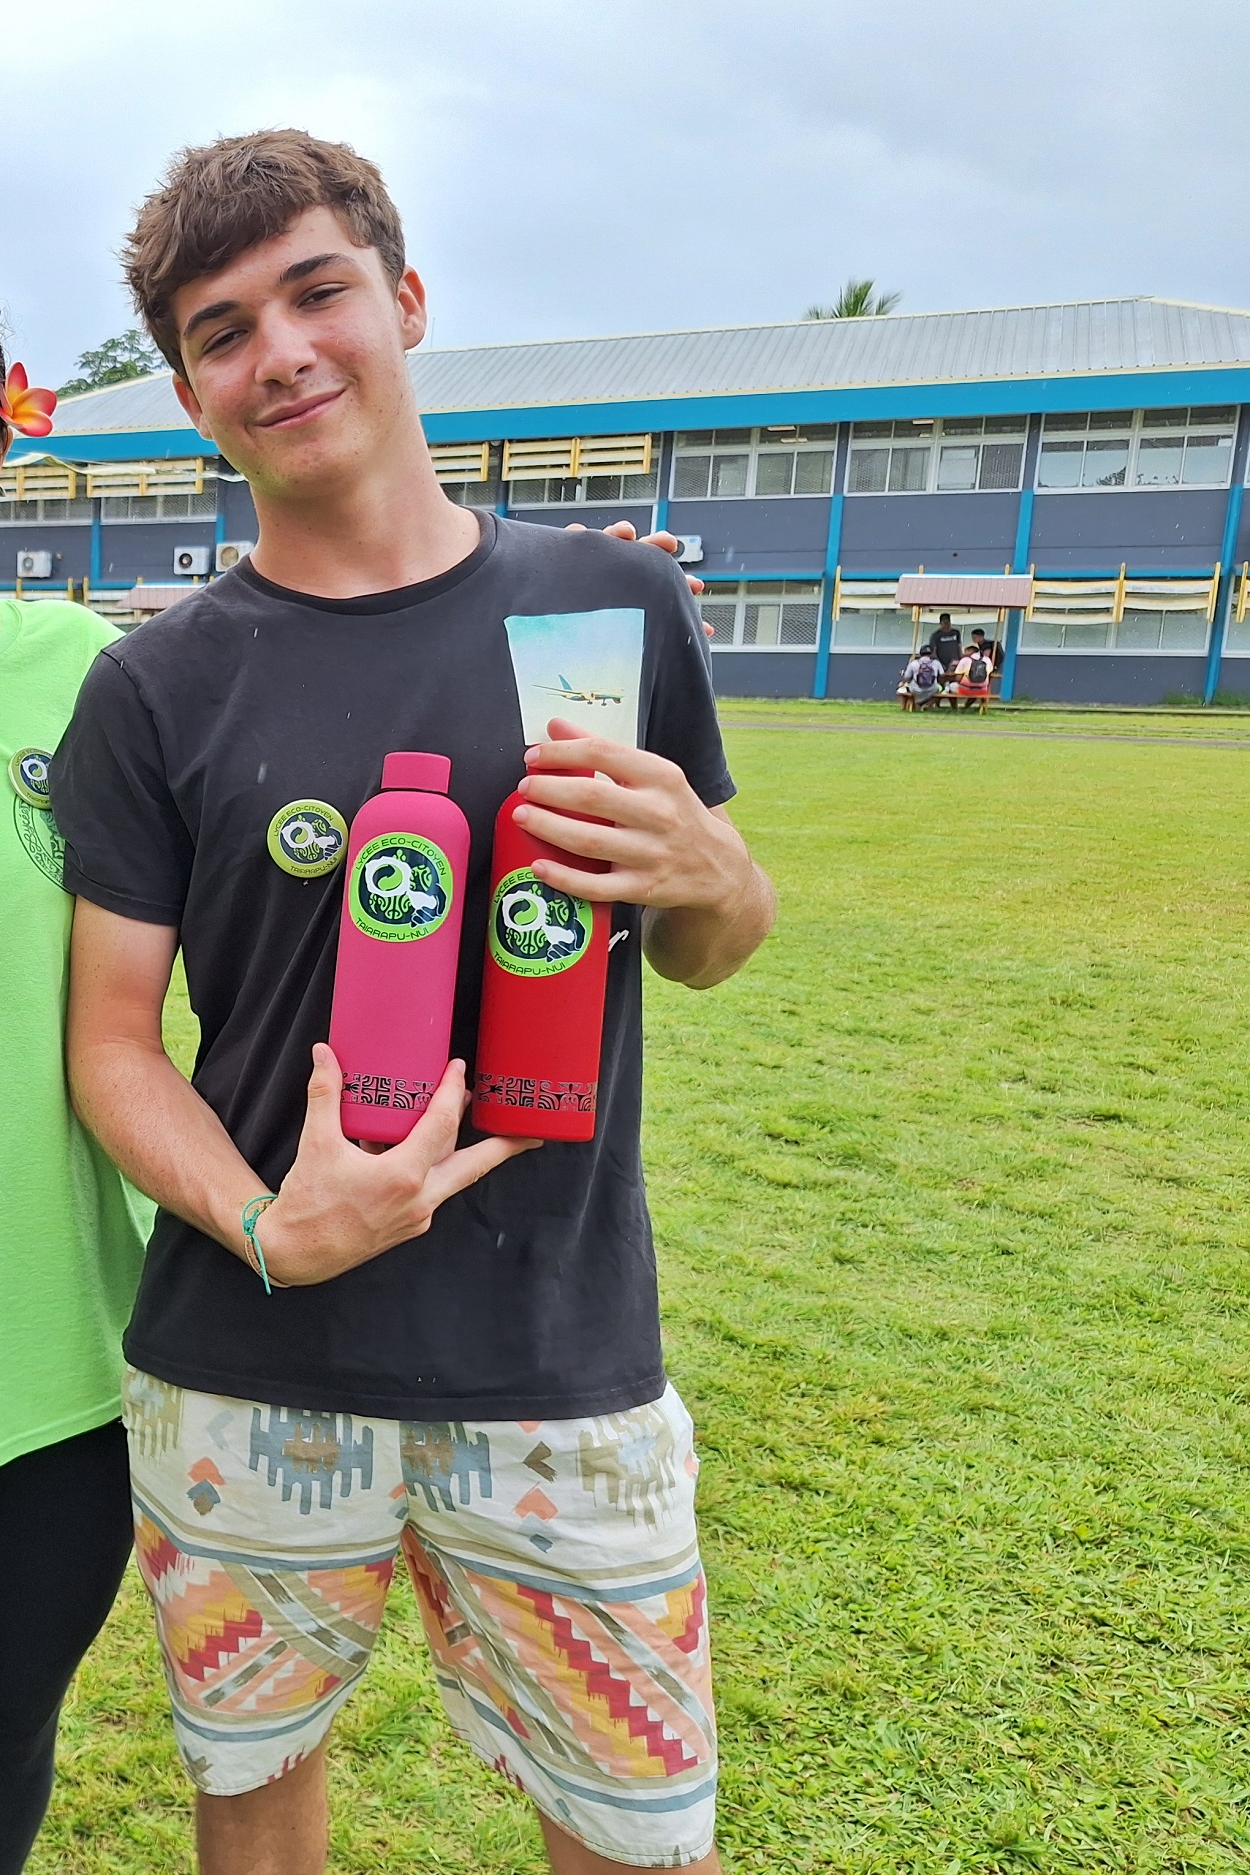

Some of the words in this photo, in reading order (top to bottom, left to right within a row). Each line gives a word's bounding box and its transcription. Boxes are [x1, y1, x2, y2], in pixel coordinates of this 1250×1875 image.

[274, 815, 287, 837] LYCEE
[286, 805, 334, 822] ECO-CITOYEN
[355, 842, 380, 871] LYCEE
[381, 837, 447, 876] ECO-CITOYEN
[494, 876, 516, 904] LYCEE
[355, 916, 430, 941] TAIARAPU-NUI
[493, 951, 567, 976] TAIARAPU-NUI
